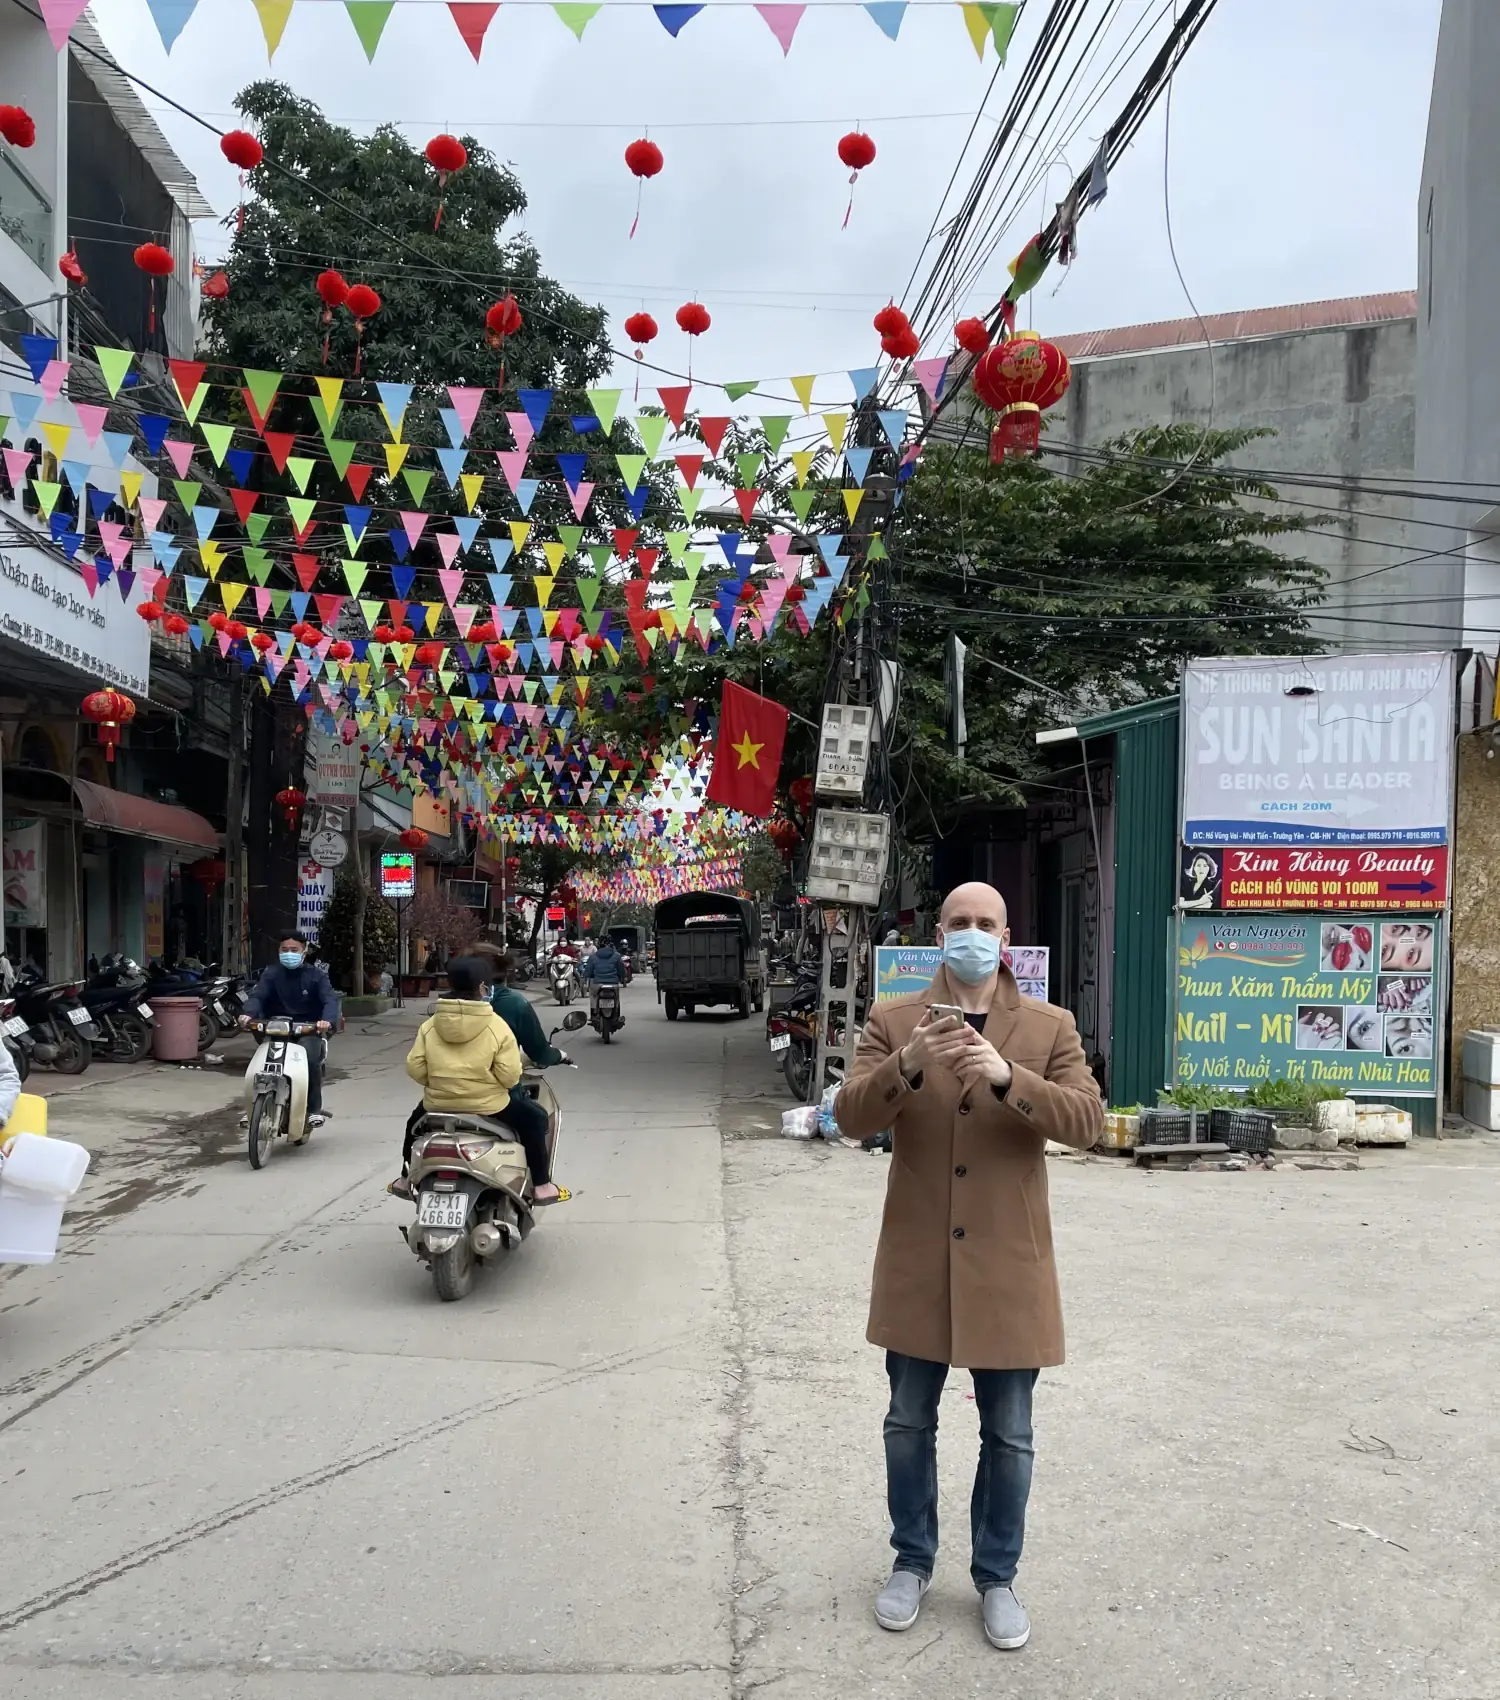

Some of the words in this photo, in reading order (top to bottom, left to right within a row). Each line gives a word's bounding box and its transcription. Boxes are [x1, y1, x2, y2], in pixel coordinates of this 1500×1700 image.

[51, 586, 67, 608] tạo
[68, 592, 85, 619] học
[1368, 669, 1401, 691] ANH
[1199, 706, 1281, 765] SUN
[1297, 703, 1435, 763] SANTA
[1219, 773, 1290, 790] BEING
[1298, 773, 1315, 790] A
[1324, 772, 1412, 790] LEADER
[1302, 802, 1332, 811] 20M
[1230, 851, 1281, 873] Kim
[1288, 851, 1351, 876] Hằng
[1357, 851, 1436, 876] Beauty
[1230, 878, 1263, 895] CÁCH
[1286, 878, 1319, 895] VŨNG
[1322, 881, 1341, 895] VOI
[1345, 881, 1379, 895] 100M
[1211, 923, 1241, 937] Vân
[1247, 923, 1307, 940] Nguyễn
[898, 952, 917, 960] Vân
[1228, 975, 1275, 998] Xăm
[1281, 972, 1335, 999] Thẩm
[1339, 977, 1373, 1004] Mỹ
[1177, 1011, 1228, 1044] Nail
[1260, 1013, 1294, 1044] Mi
[1178, 1052, 1198, 1080] ẩy
[1201, 1055, 1231, 1078] Nốt
[1234, 1054, 1271, 1078] Ruồi
[1310, 1060, 1354, 1080] Thâm
[1358, 1061, 1393, 1081] Nhũ
[1396, 1061, 1430, 1083] Hoa
[426, 1194, 460, 1209] 29-X1
[421, 1210, 462, 1225] 466.86
